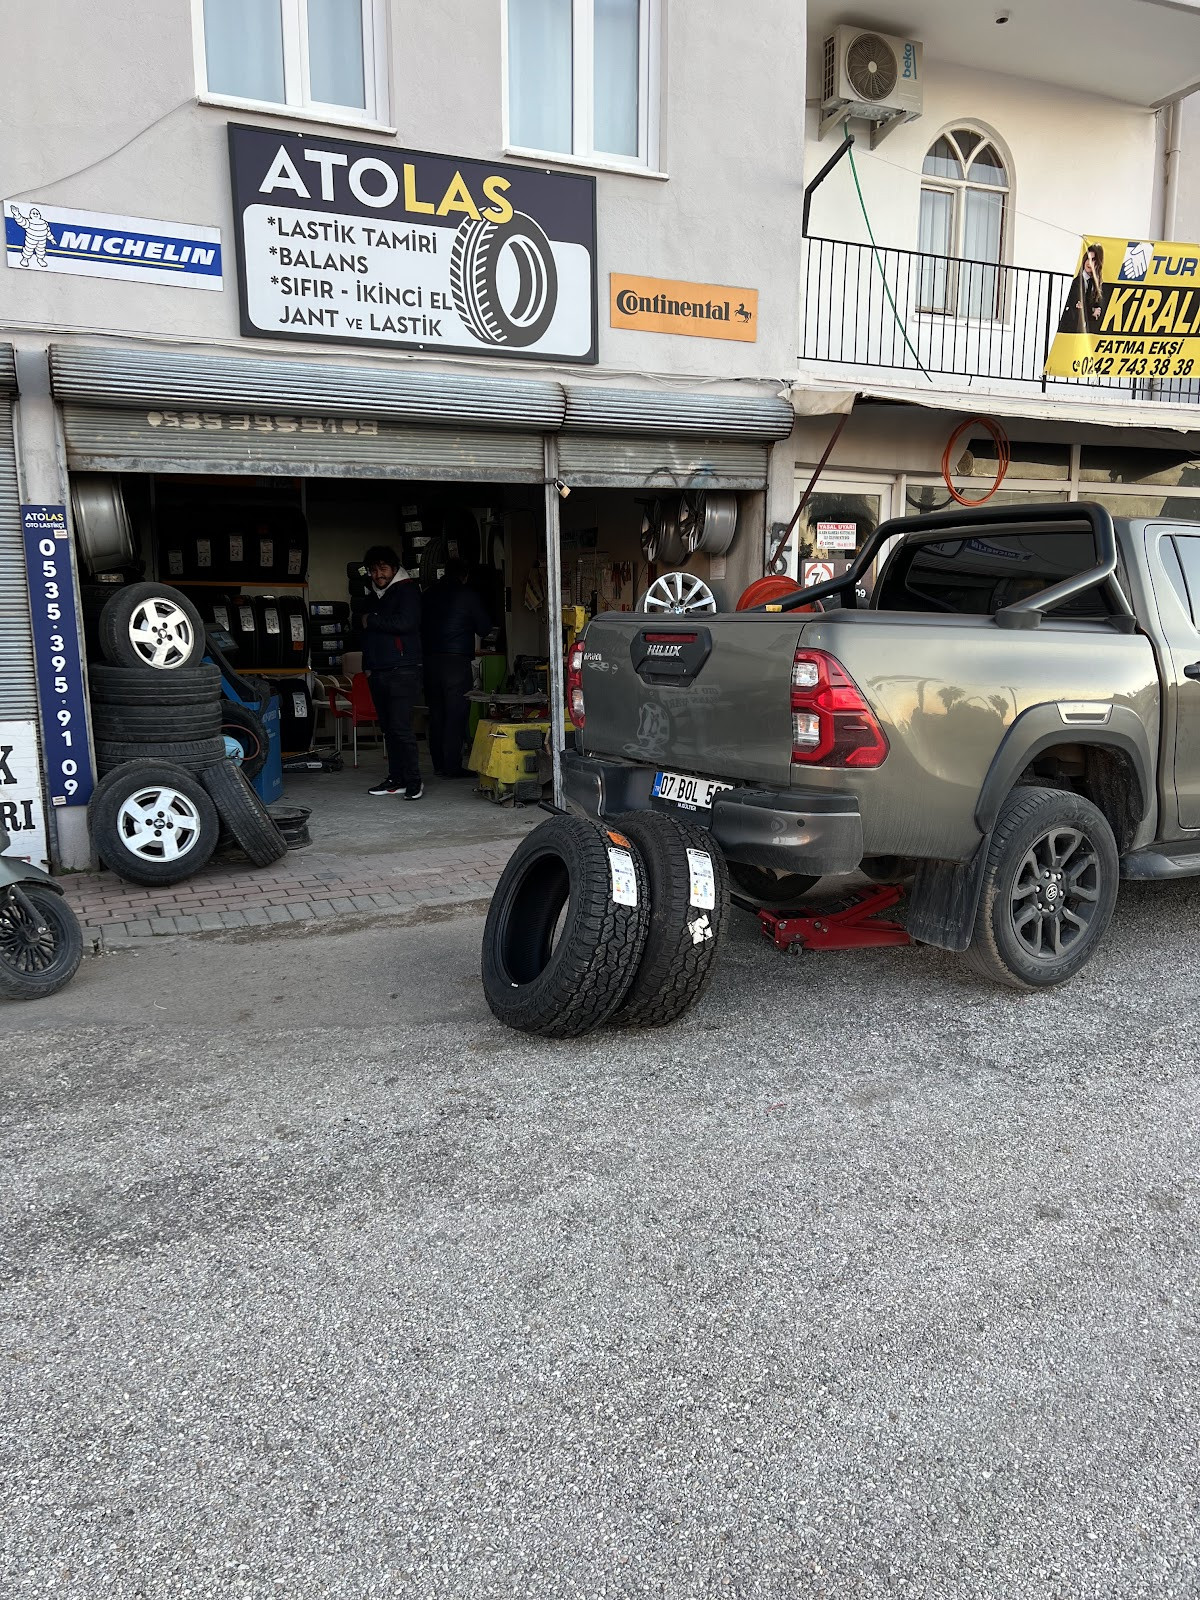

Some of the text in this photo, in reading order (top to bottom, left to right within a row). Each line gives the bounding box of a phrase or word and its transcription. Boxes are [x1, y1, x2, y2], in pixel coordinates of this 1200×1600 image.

[902, 43, 912, 78] beko
[259, 144, 514, 224] ATOLAS
[59, 231, 216, 266] MICHELIN
[362, 228, 437, 254] TAMİRİ
[356, 280, 423, 308] İKİNCİ
[430, 291, 453, 310] EL
[616, 289, 730, 322] Continental
[279, 306, 339, 328] JANT
[370, 314, 443, 337] LASTİK
[1094, 338, 1184, 358] FATMA EKŞİ
[1116, 357, 1147, 376] 743
[1150, 358, 1171, 376] 38
[1173, 358, 1195, 376] 38
[25, 512, 64, 522] ATOLAS
[647, 644, 682, 657] HILUX
[660, 775, 676, 797] 07
[677, 778, 698, 802] BOL
